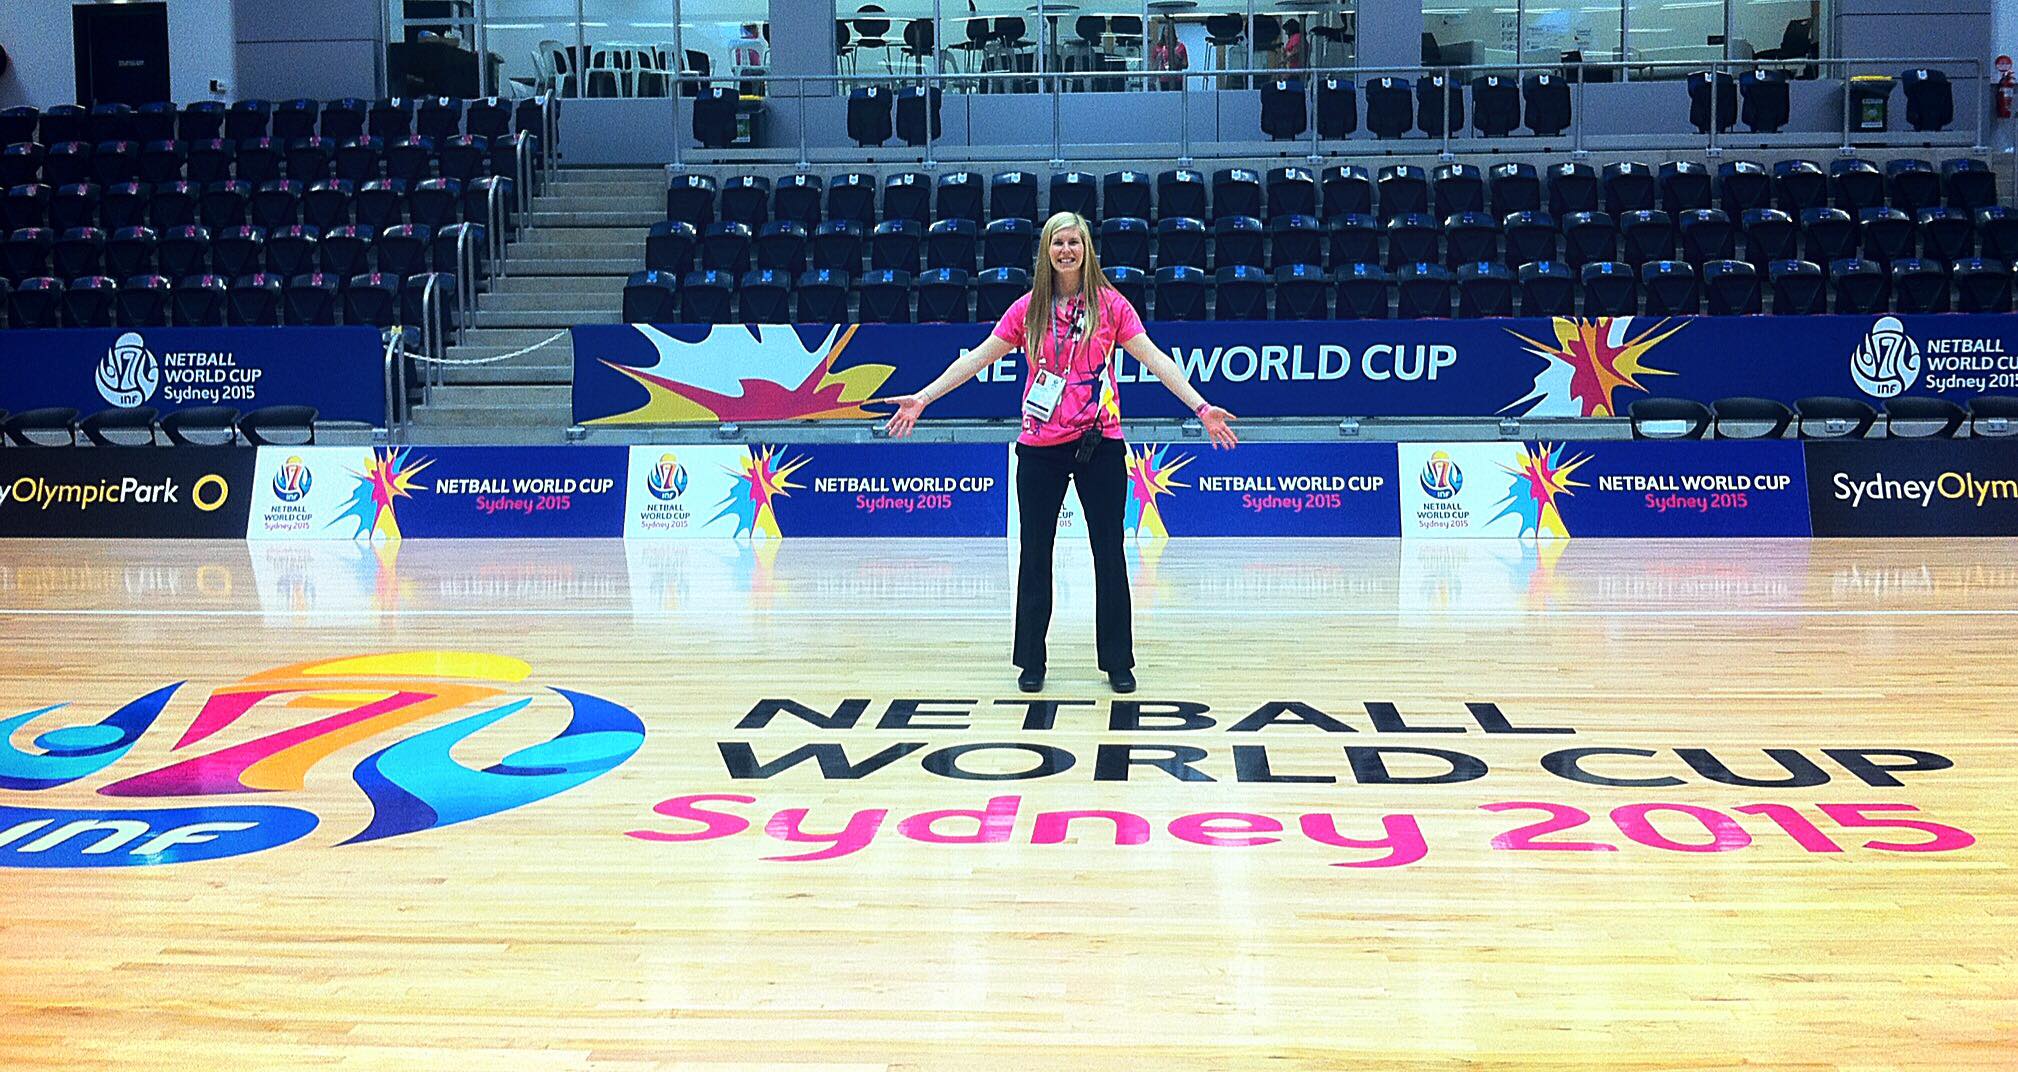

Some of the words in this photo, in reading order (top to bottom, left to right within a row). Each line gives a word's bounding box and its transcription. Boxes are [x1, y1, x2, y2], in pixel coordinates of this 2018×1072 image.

[1927, 339, 2004, 353] NETBALL
[164, 352, 236, 366] NETBALL
[1172, 345, 1350, 382] WORLD
[1361, 344, 1457, 381] CUP
[1927, 357, 1994, 371] WORLD
[164, 369, 226, 383] WORLD
[229, 369, 262, 383] CUP
[1926, 374, 1986, 393] Sydney
[164, 386, 219, 404] Sydney
[222, 385, 255, 399] 2015
[436, 479, 510, 494] NETBALL
[512, 478, 577, 494] WORLD
[579, 478, 614, 494] CUP
[814, 477, 889, 492] NETBALL
[892, 477, 957, 492] WORLD
[959, 477, 994, 492] CUP
[1199, 476, 1276, 491] NETBALL
[1278, 476, 1345, 491] WORLD
[1348, 476, 1384, 491] CUP
[1599, 476, 1679, 491] NETBALL
[1681, 476, 1751, 491] WORLD
[1754, 475, 1791, 491] CUP
[476, 496, 533, 514] Sydney
[536, 496, 571, 510] 2015
[856, 495, 914, 513] Sydney
[917, 495, 952, 509] 2015
[1242, 494, 1302, 512] Sydney
[1305, 494, 1341, 509] 2015
[1645, 493, 1708, 513] Sydney
[1711, 493, 1748, 508] 2015
[640, 512, 672, 520] WORLD
[674, 512, 691, 520] CUP
[1417, 511, 1450, 519] WORLD
[1452, 511, 1469, 519] CUP
[641, 521, 670, 530] Sydney
[1419, 520, 1449, 529] Sydney
[735, 699, 1577, 735] NETBALL
[718, 742, 1489, 787] WORLD
[1541, 748, 1954, 788] CUP
[625, 795, 1429, 869] Sydney
[1479, 801, 1976, 853] 2015
